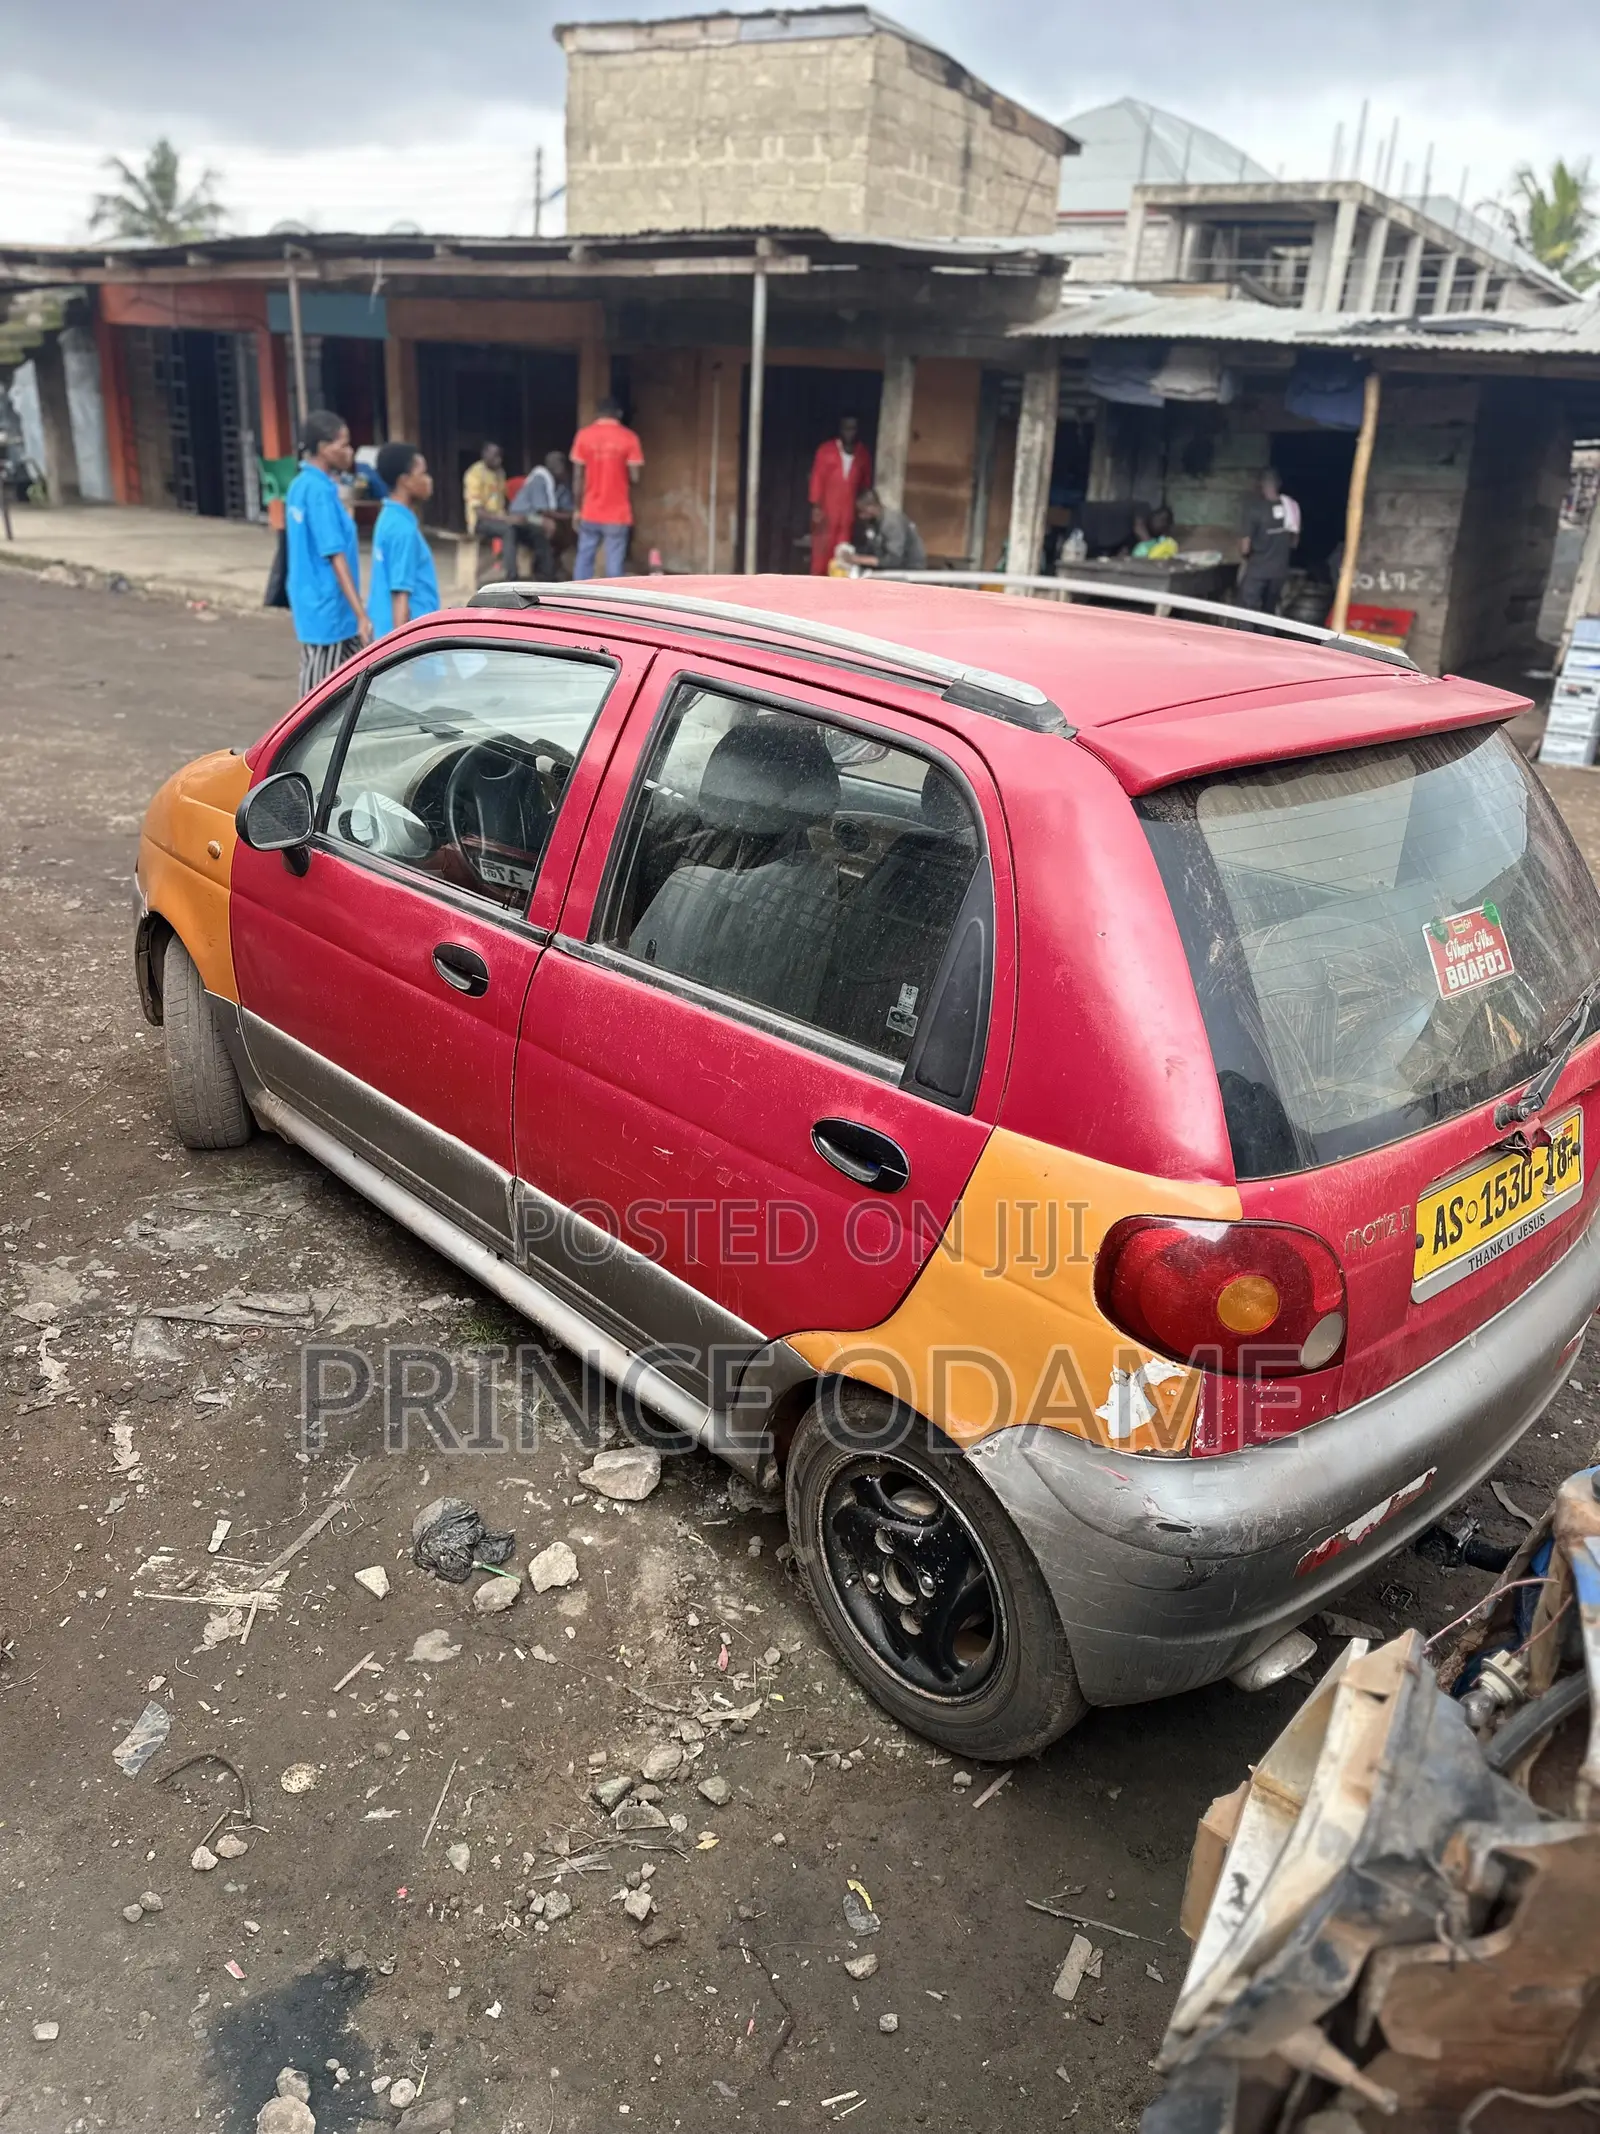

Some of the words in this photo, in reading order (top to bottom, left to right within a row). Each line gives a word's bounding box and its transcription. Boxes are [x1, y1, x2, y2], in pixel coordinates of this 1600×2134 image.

[1432, 1195, 1464, 1256] AS
[1467, 1243, 1503, 1271] THANK
[1507, 1230, 1515, 1248] U
[1517, 1212, 1547, 1241] JESUS
